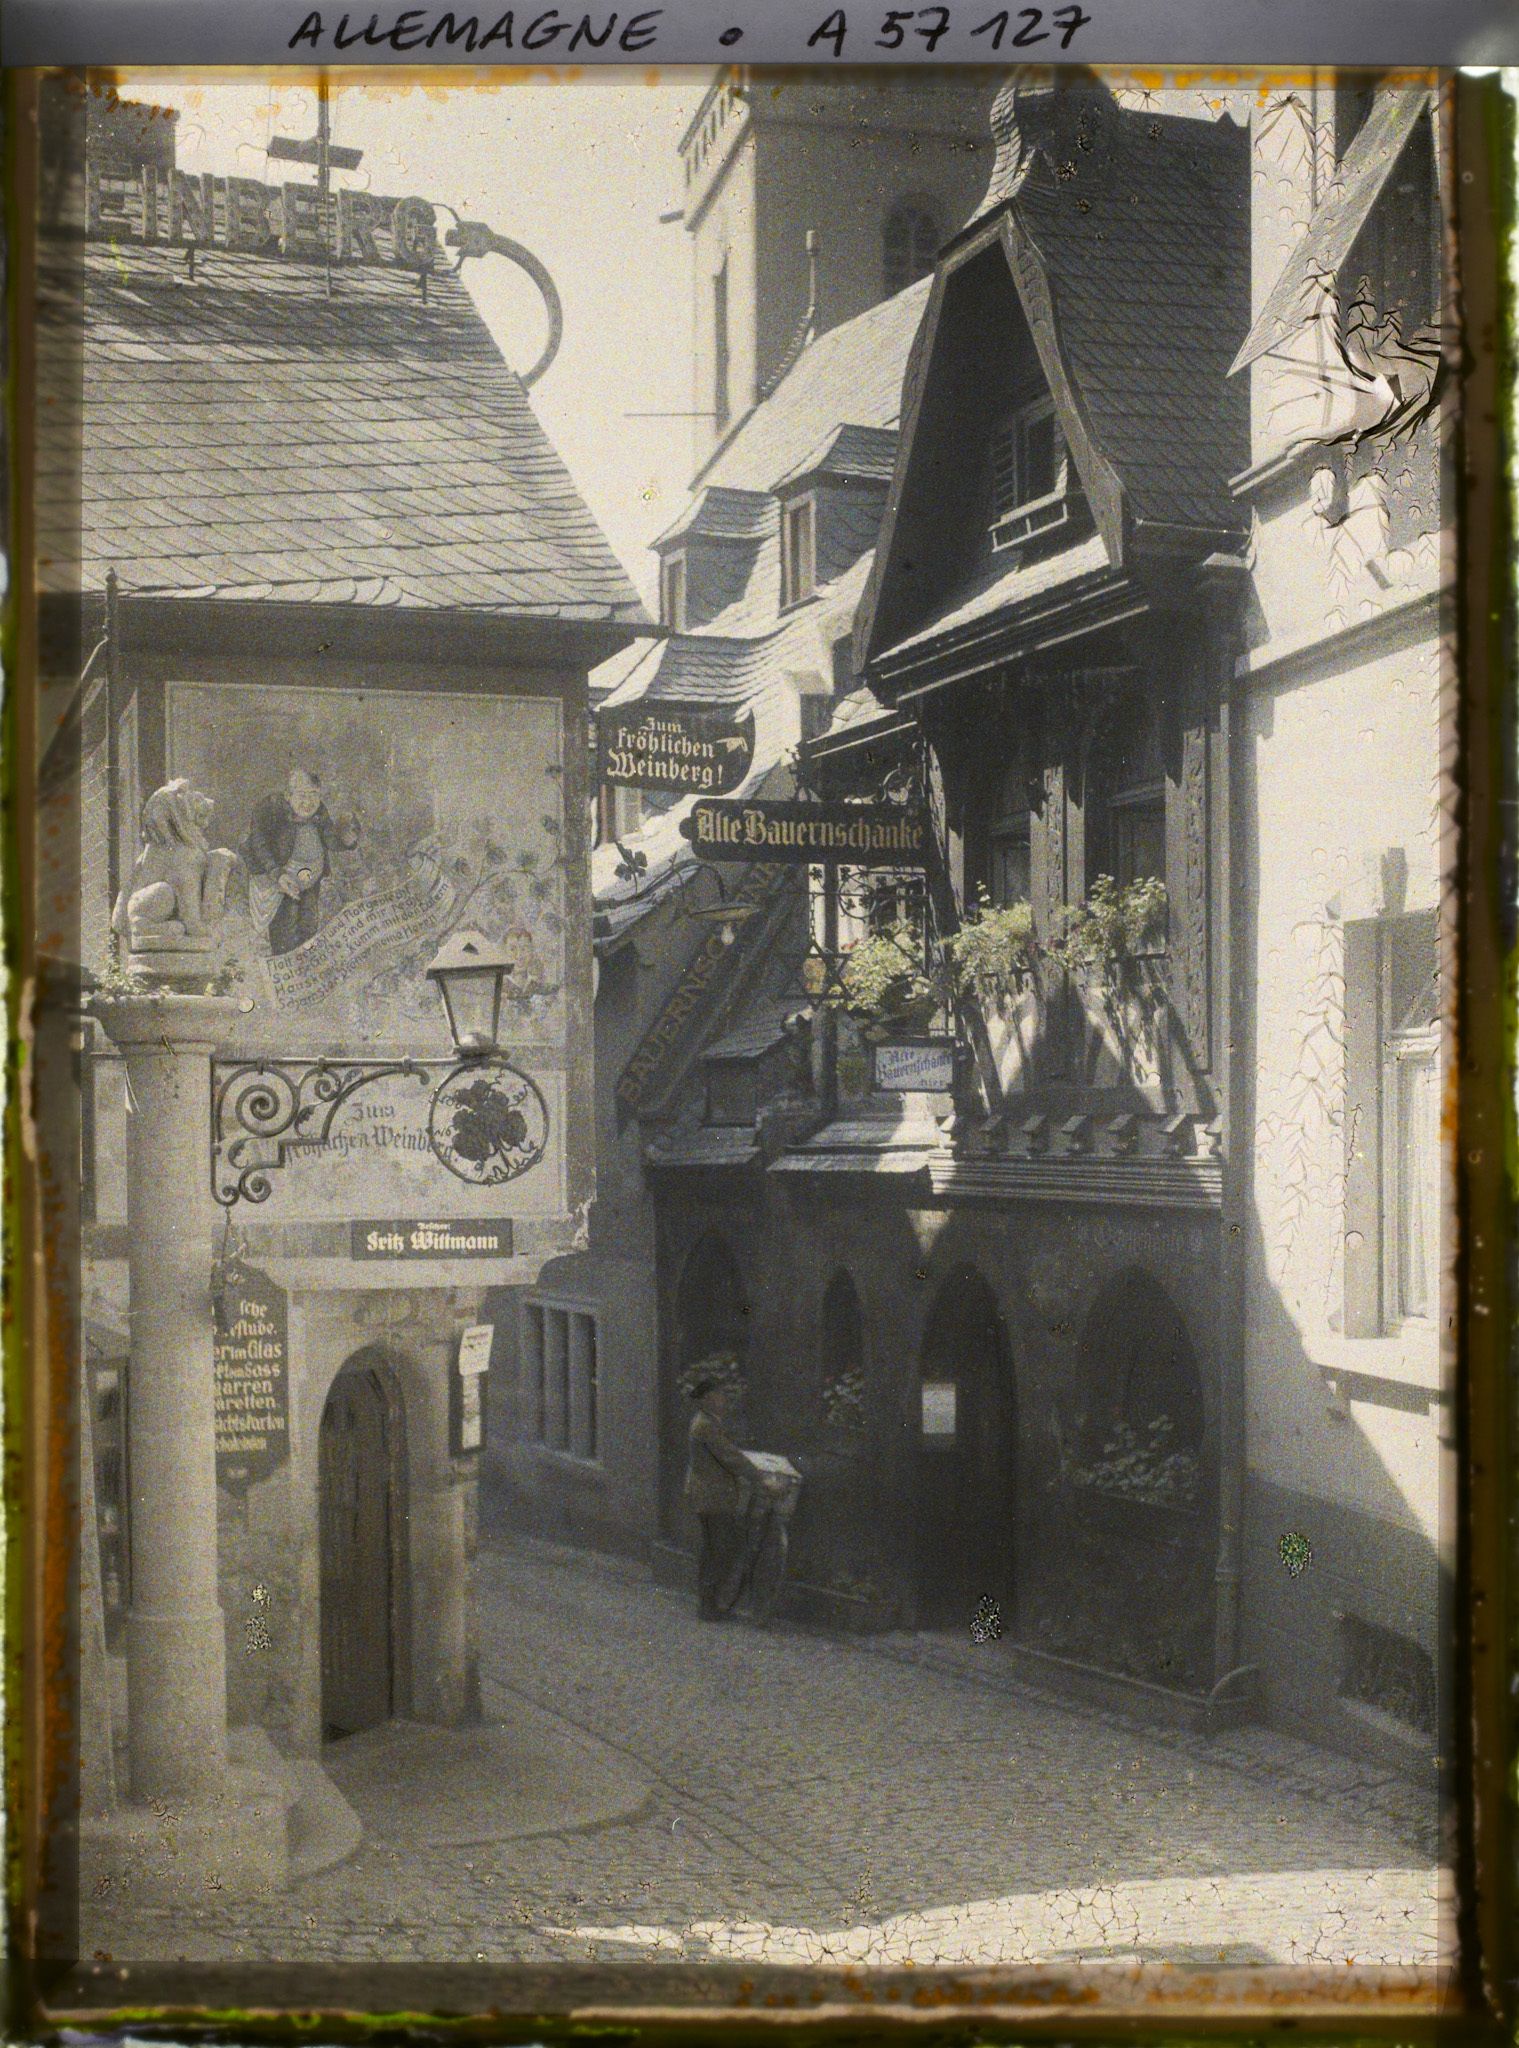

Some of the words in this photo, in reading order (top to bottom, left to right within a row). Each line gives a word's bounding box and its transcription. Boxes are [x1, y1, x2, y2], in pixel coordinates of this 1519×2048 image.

[288, 10, 664, 53] ALLEMAGNE
[806, 9, 848, 57] A
[874, 7, 950, 53] 57
[970, 5, 1092, 50] 127
[696, 808, 742, 843] Alte
